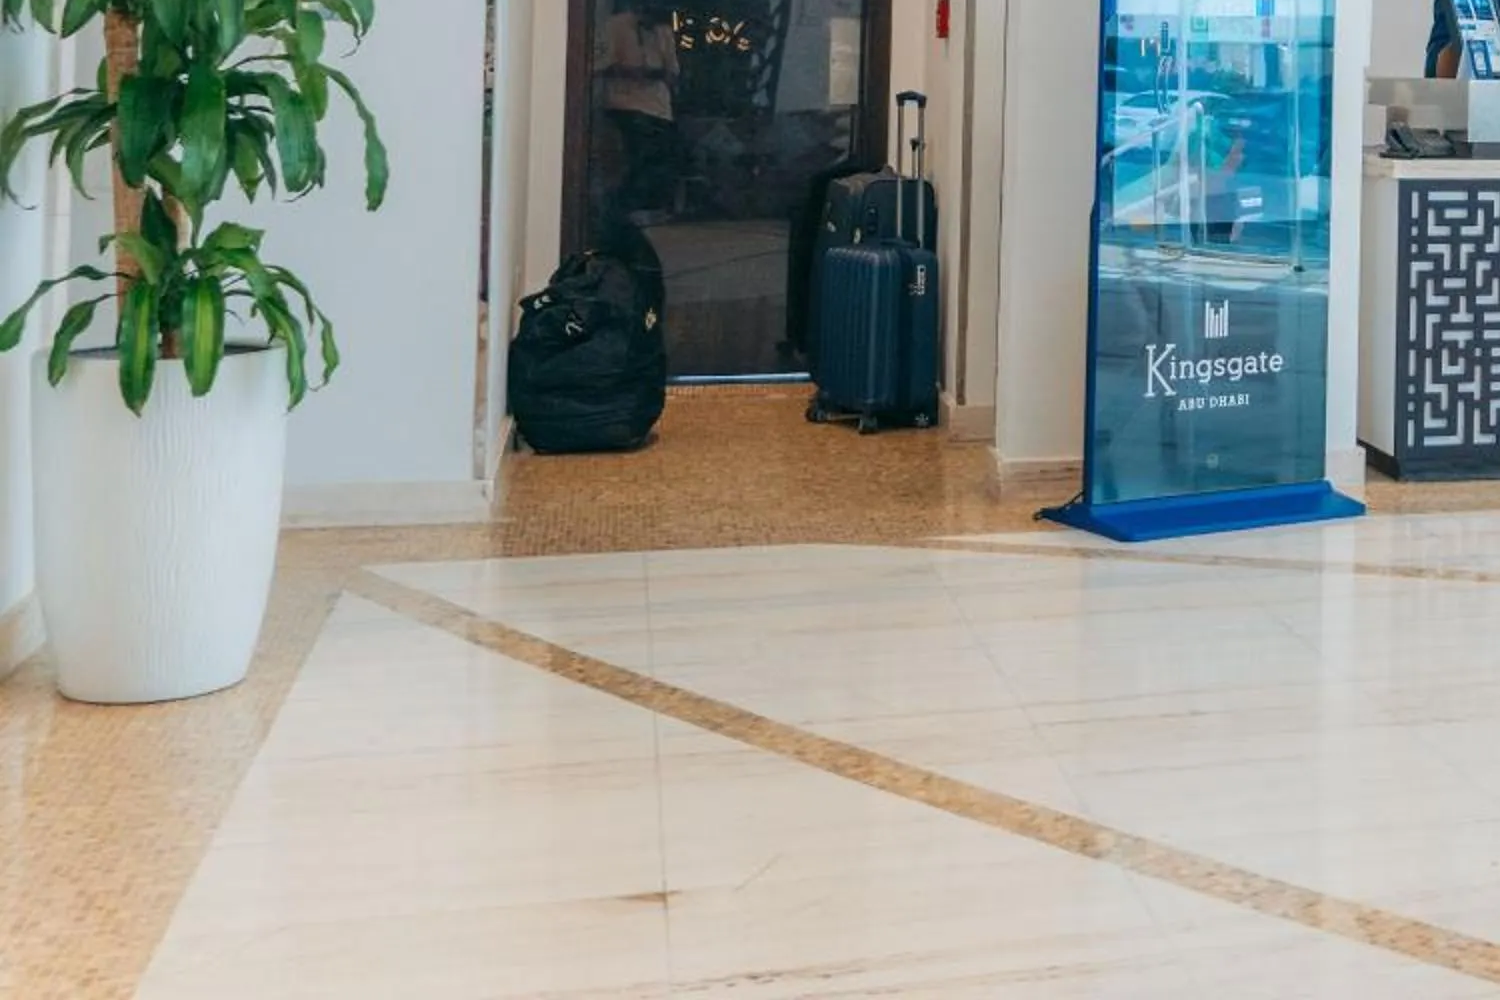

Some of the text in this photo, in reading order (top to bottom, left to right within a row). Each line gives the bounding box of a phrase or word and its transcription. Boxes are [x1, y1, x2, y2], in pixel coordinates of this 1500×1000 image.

[1143, 343, 1284, 398] Kingsgate
[1177, 393, 1249, 411] ABU DHABI
